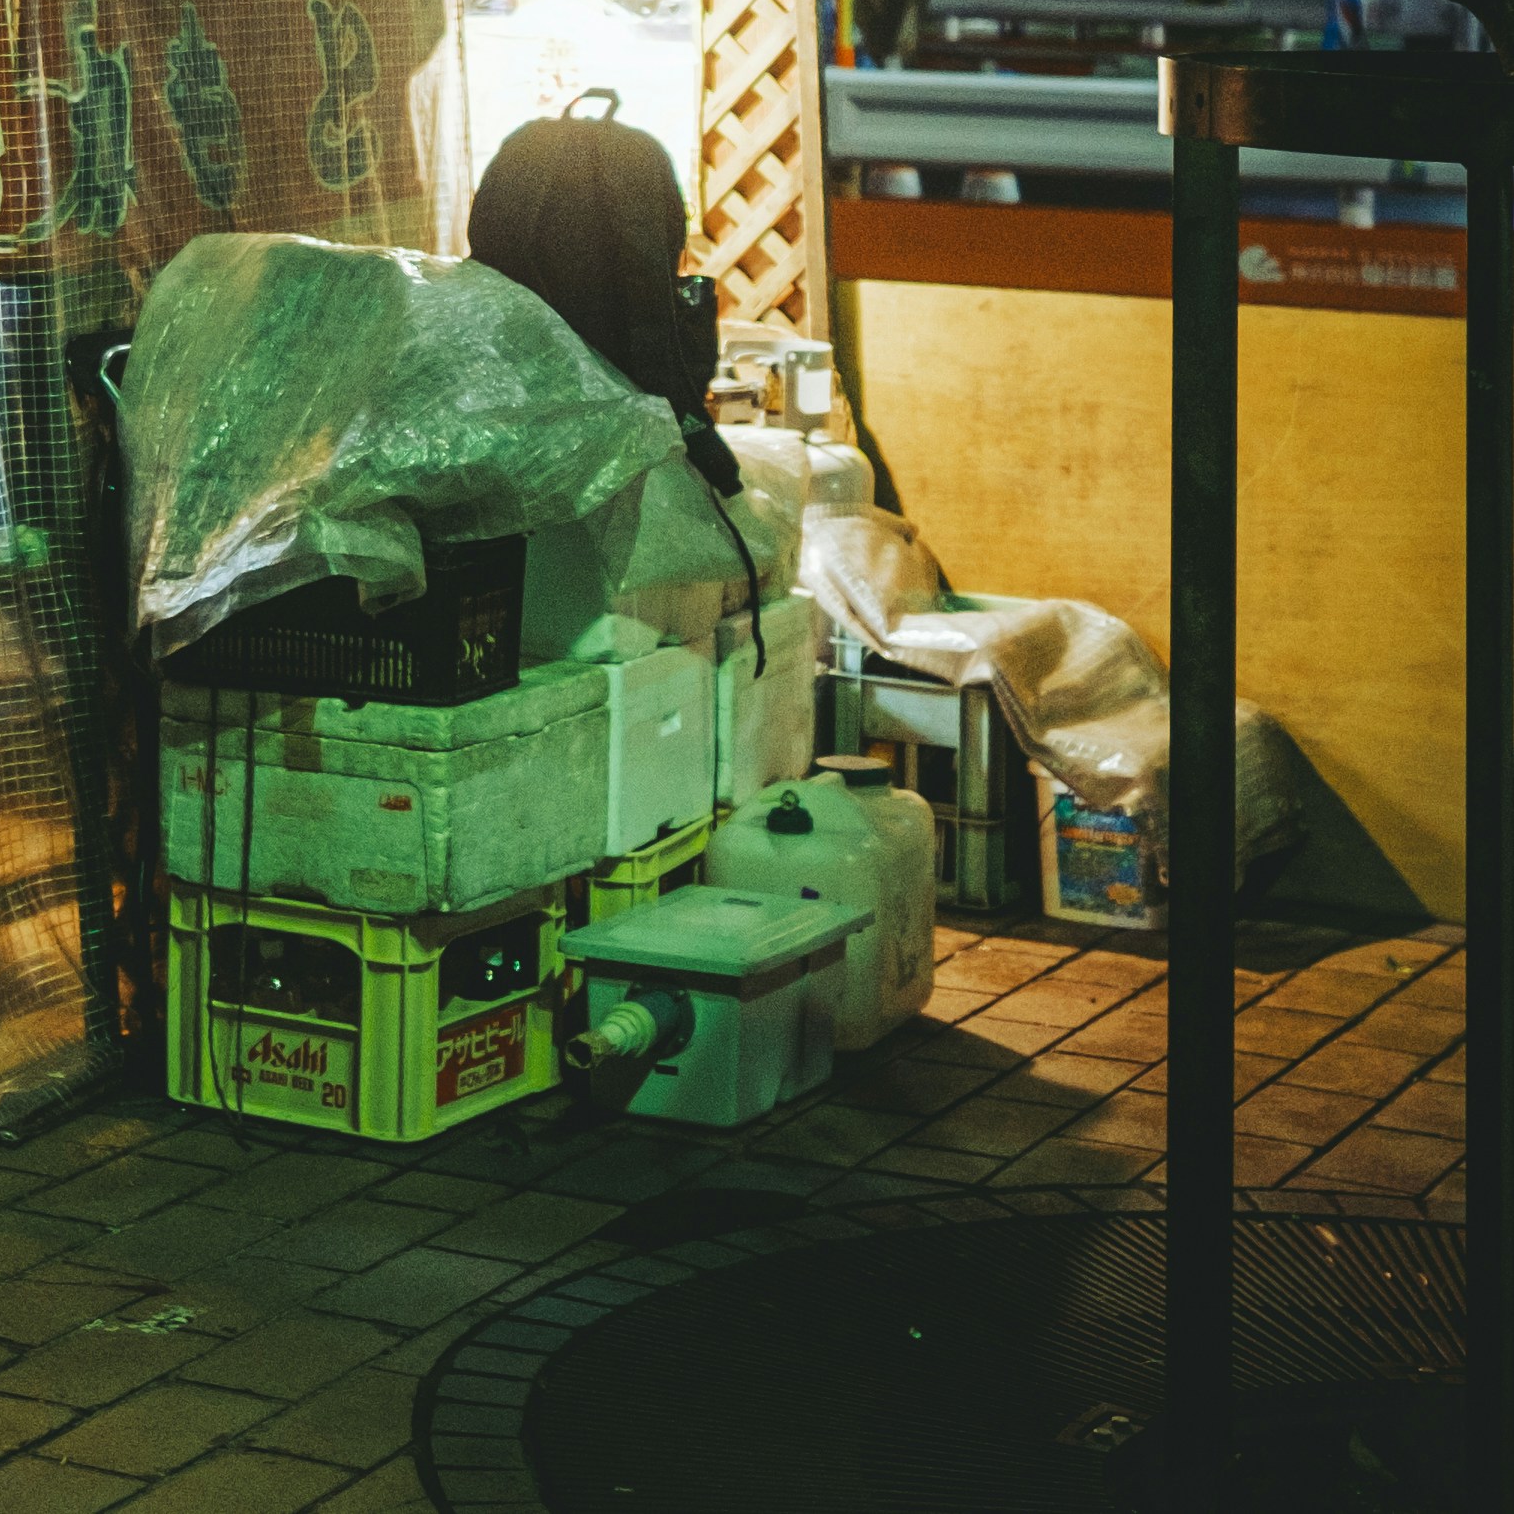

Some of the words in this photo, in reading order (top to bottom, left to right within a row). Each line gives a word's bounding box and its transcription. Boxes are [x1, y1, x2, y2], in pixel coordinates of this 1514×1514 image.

[247, 1030, 328, 1077] Asahi
[436, 1012, 525, 1074] アサヒビール
[321, 1081, 347, 1109] 20
